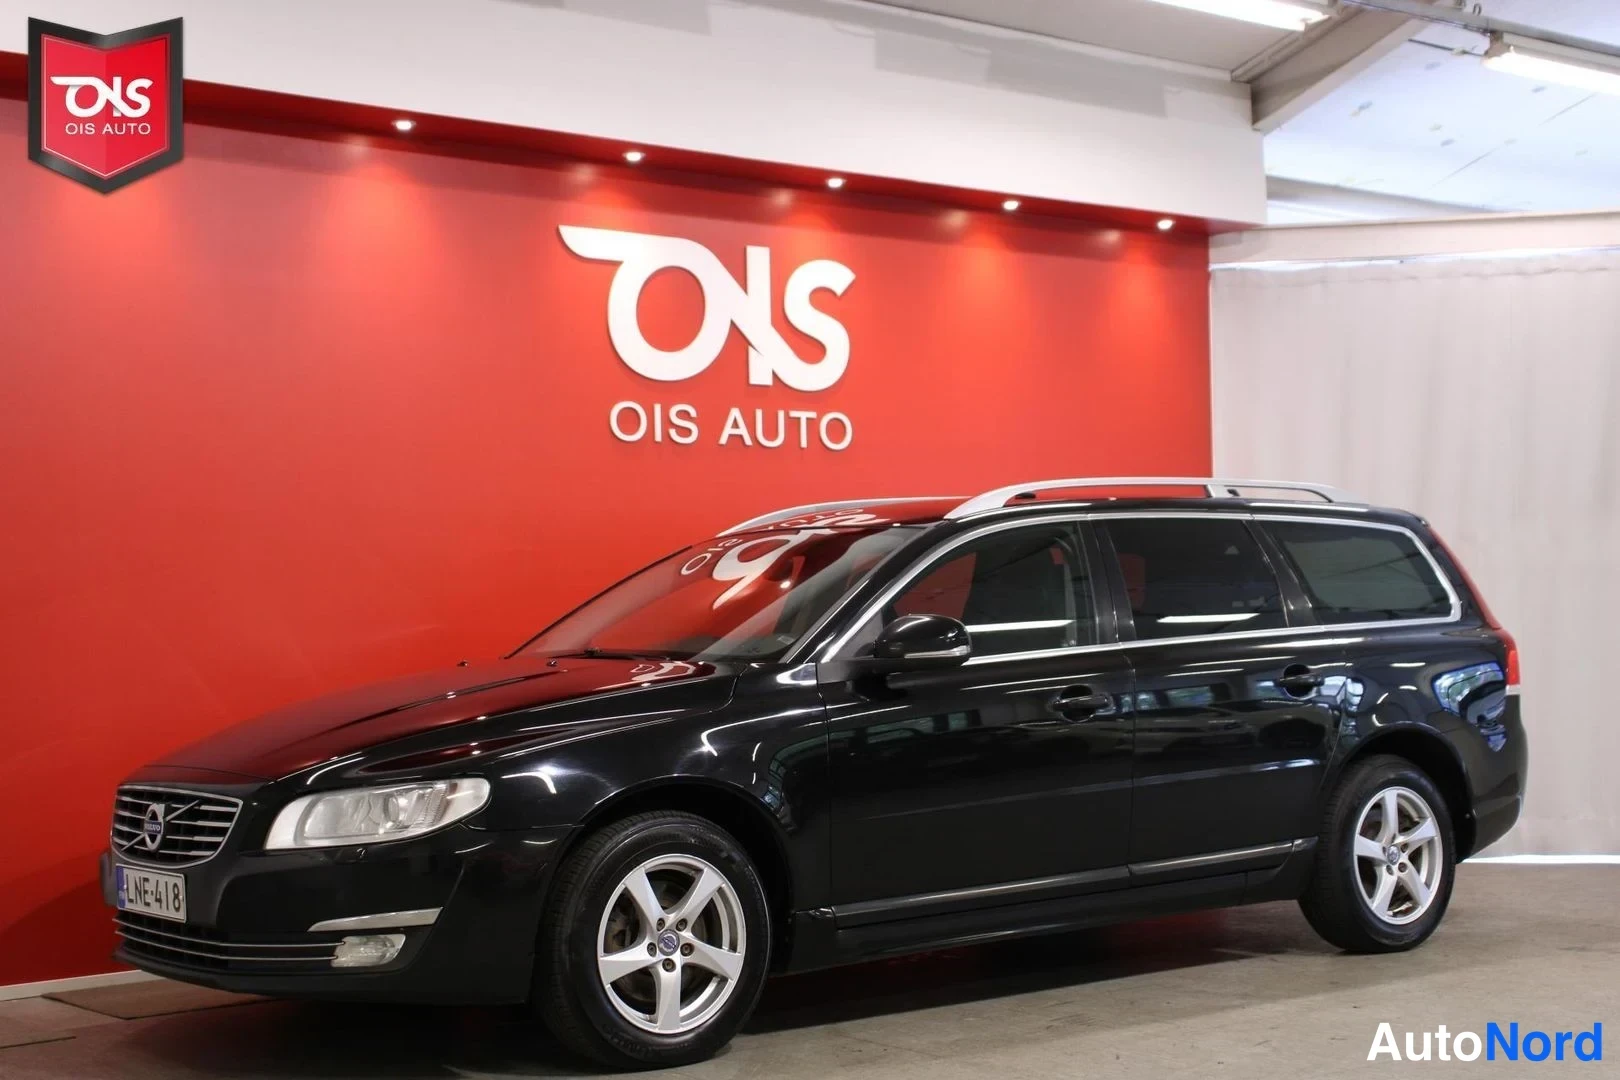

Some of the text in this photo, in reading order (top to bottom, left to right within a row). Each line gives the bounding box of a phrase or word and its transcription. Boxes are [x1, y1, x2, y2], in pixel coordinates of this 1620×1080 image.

[608, 400, 854, 451] OIS AUTO
[125, 873, 181, 913] LNE-418
